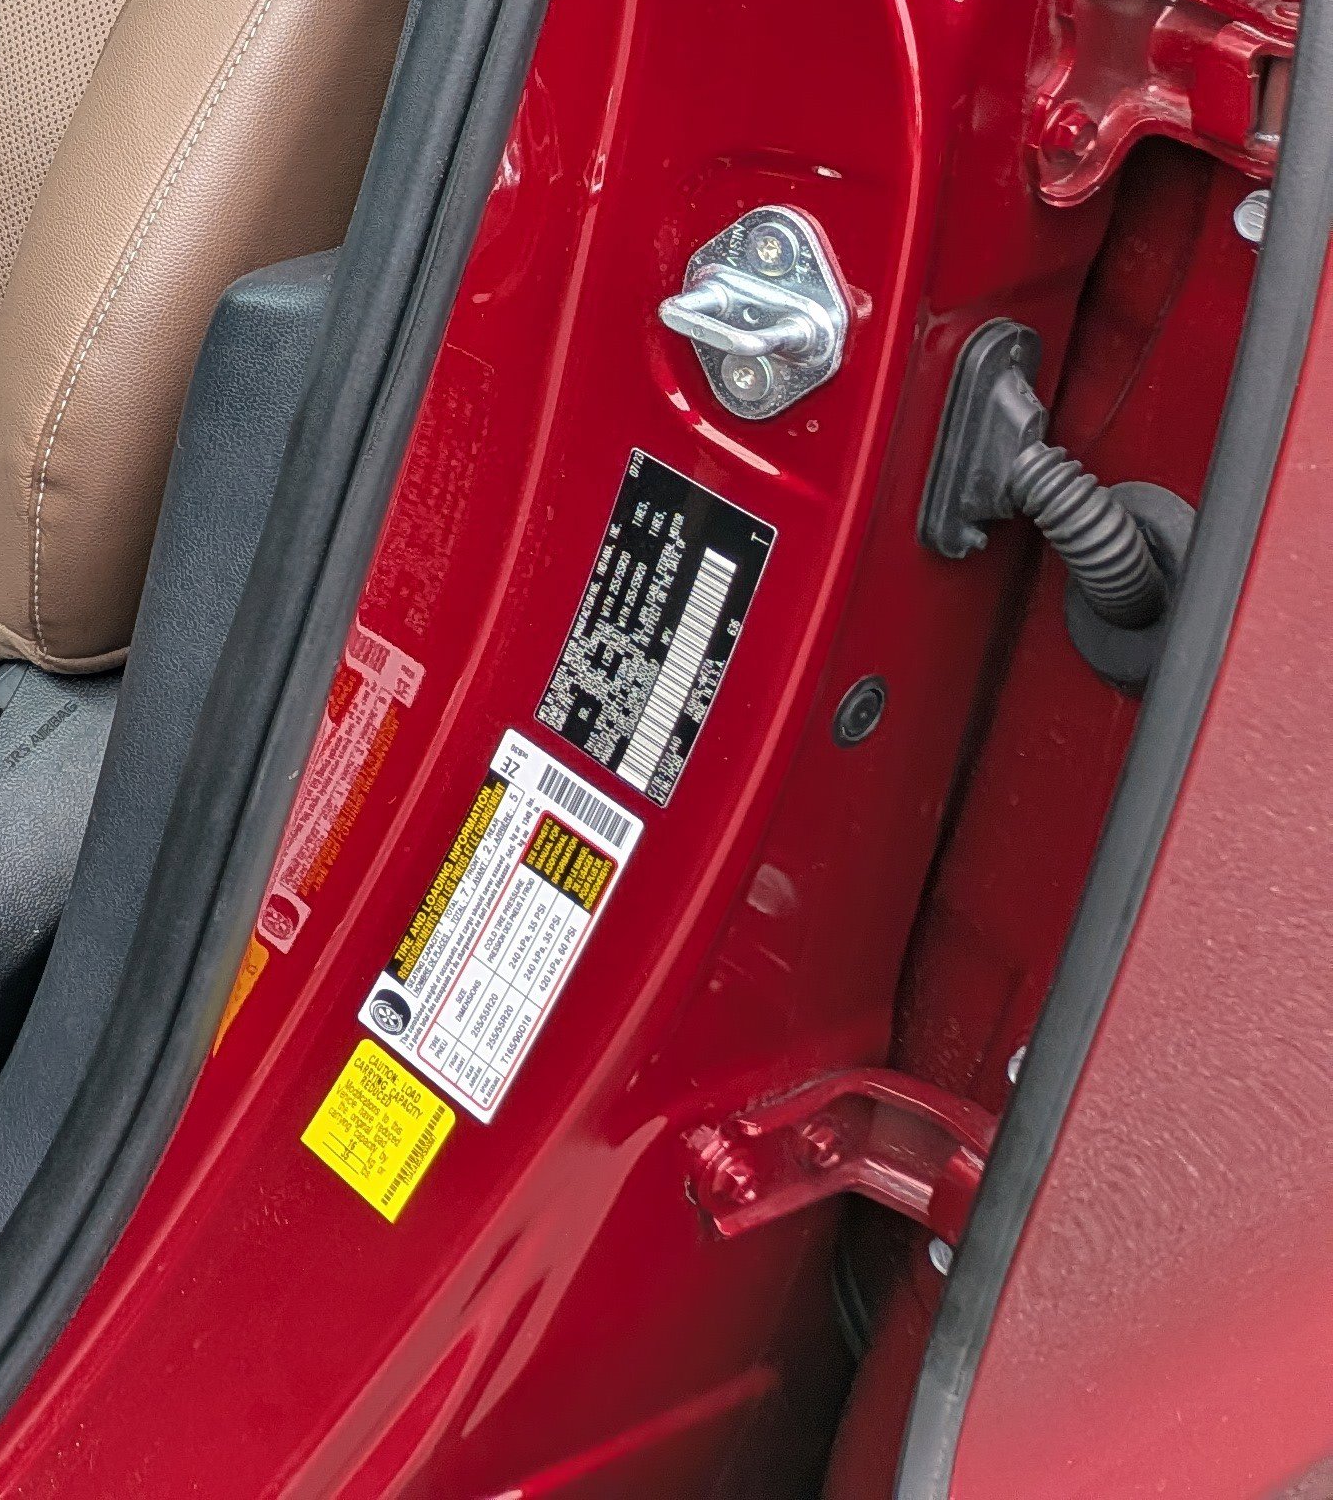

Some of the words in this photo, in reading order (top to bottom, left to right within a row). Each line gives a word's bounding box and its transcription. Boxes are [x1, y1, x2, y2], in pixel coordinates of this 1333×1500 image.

[628, 451, 645, 478] 07/23
[674, 534, 688, 550] OF
[666, 548, 682, 572] DATE
[599, 594, 615, 618] WITH
[607, 549, 632, 595] 255/55R20
[615, 604, 631, 629] WITH
[623, 560, 648, 607] 255/55R20
[655, 588, 668, 604] ON
[660, 570, 675, 590] THE
[583, 729, 598, 753] THIS
[593, 694, 614, 732] VEHICLE
[609, 655, 631, 697] CONFORMS
[625, 641, 637, 655] TO
[636, 575, 663, 626] APPLICABLE
[654, 539, 676, 576] FEDERAL
[666, 511, 685, 540] MOTOR
[643, 602, 663, 635] EFFECT
[658, 625, 674, 646] MPV
[691, 700, 707, 724] MADE
[701, 685, 713, 699] IN
[725, 617, 739, 636] 636
[749, 530, 771, 549] T
[561, 637, 577, 665] MOTOR
[638, 633, 651, 647] IN
[620, 646, 646, 694] STANDARDS
[30, 700, 77, 747] AIRBAG
[607, 690, 626, 724] SAFETY
[592, 722, 612, 760] VEHICLE
[599, 710, 628, 766] MANUFACTURE
[623, 683, 640, 711] SHOWN
[498, 754, 521, 779] ZE
[473, 781, 507, 836] CHARGEMENT
[508, 791, 519, 803] 5
[468, 832, 480, 846] LE
[485, 816, 500, 839] REAR
[462, 842, 475, 857] ET
[482, 844, 492, 855] 2
[525, 848, 538, 865] SEE
[533, 839, 553, 870] MANUAL
[548, 824, 561, 841] FOR
[542, 832, 569, 875] ADDITIONAL
[550, 835, 579, 884] INFORMATION
[394, 934, 414, 963] TIRE
[408, 909, 427, 938] AND
[421, 859, 454, 913] LOADING
[447, 785, 492, 862] INFORMATION
[449, 853, 469, 882] PNEUS
[464, 853, 481, 880] FRONT
[578, 881, 591, 900] POUR
[586, 866, 599, 884] PLUS
[594, 857, 603, 868] DE
[432, 894, 448, 914] SUR
[441, 879, 456, 898] LES
[459, 886, 470, 898] 7
[443, 897, 459, 919] TOTAL
[483, 929, 498, 951] COLD
[493, 913, 506, 931] TIRE
[501, 877, 525, 916] PRESSURE
[487, 932, 506, 964] PRESSION
[502, 920, 513, 935] DES
[508, 900, 523, 922] PNEUS
[521, 876, 536, 897] FROID
[397, 910, 439, 981] RENSEIGNEMENTS
[421, 928, 441, 962] CAPACITY
[507, 950, 521, 970] 240
[527, 918, 538, 932] 35
[533, 902, 546, 921] PSI
[522, 962, 536, 981] 240
[541, 929, 553, 944] 35
[548, 913, 561, 932] PSI
[399, 1031, 410, 1046] The
[406, 1002, 426, 1034] combined
[422, 981, 438, 1005] weight
[434, 974, 442, 984] of
[438, 944, 458, 977] occupants
[454, 932, 464, 946] and
[461, 915, 474, 935] cargo
[469, 894, 485, 917] should
[406, 959, 425, 989] SEATING
[413, 966, 431, 995] NOMBRE
[427, 956, 436, 968] DE
[433, 932, 449, 958] PLACES
[537, 973, 551, 993] 420
[556, 941, 568, 956] 60
[563, 925, 577, 943] PSI
[454, 986, 467, 1005] SIZE
[455, 978, 481, 1023] DIMENSIONS
[419, 1011, 430, 1028] total
[469, 990, 499, 1039] 255/55R20
[484, 1002, 514, 1051] 255/55R20
[428, 1033, 440, 1051] TIRE
[434, 1038, 448, 1059] PNEU
[352, 1056, 389, 1091] CARRYING
[387, 1086, 423, 1121] CAPACITY
[358, 1074, 392, 1108] REDUCED
[400, 1081, 422, 1104] LOAD
[334, 1084, 359, 1109] Vehicle
[357, 1106, 374, 1124] have
[374, 1119, 402, 1147] reduced
[343, 1078, 382, 1116] Modifications
[381, 1112, 391, 1124] to
[390, 1119, 404, 1136] this
[326, 1105, 353, 1133] carrying
[351, 1128, 378, 1155] capacity
[377, 1150, 389, 1165] by
[337, 1100, 349, 1115] the
[348, 1110, 373, 1137] original
[372, 1131, 388, 1149] load
